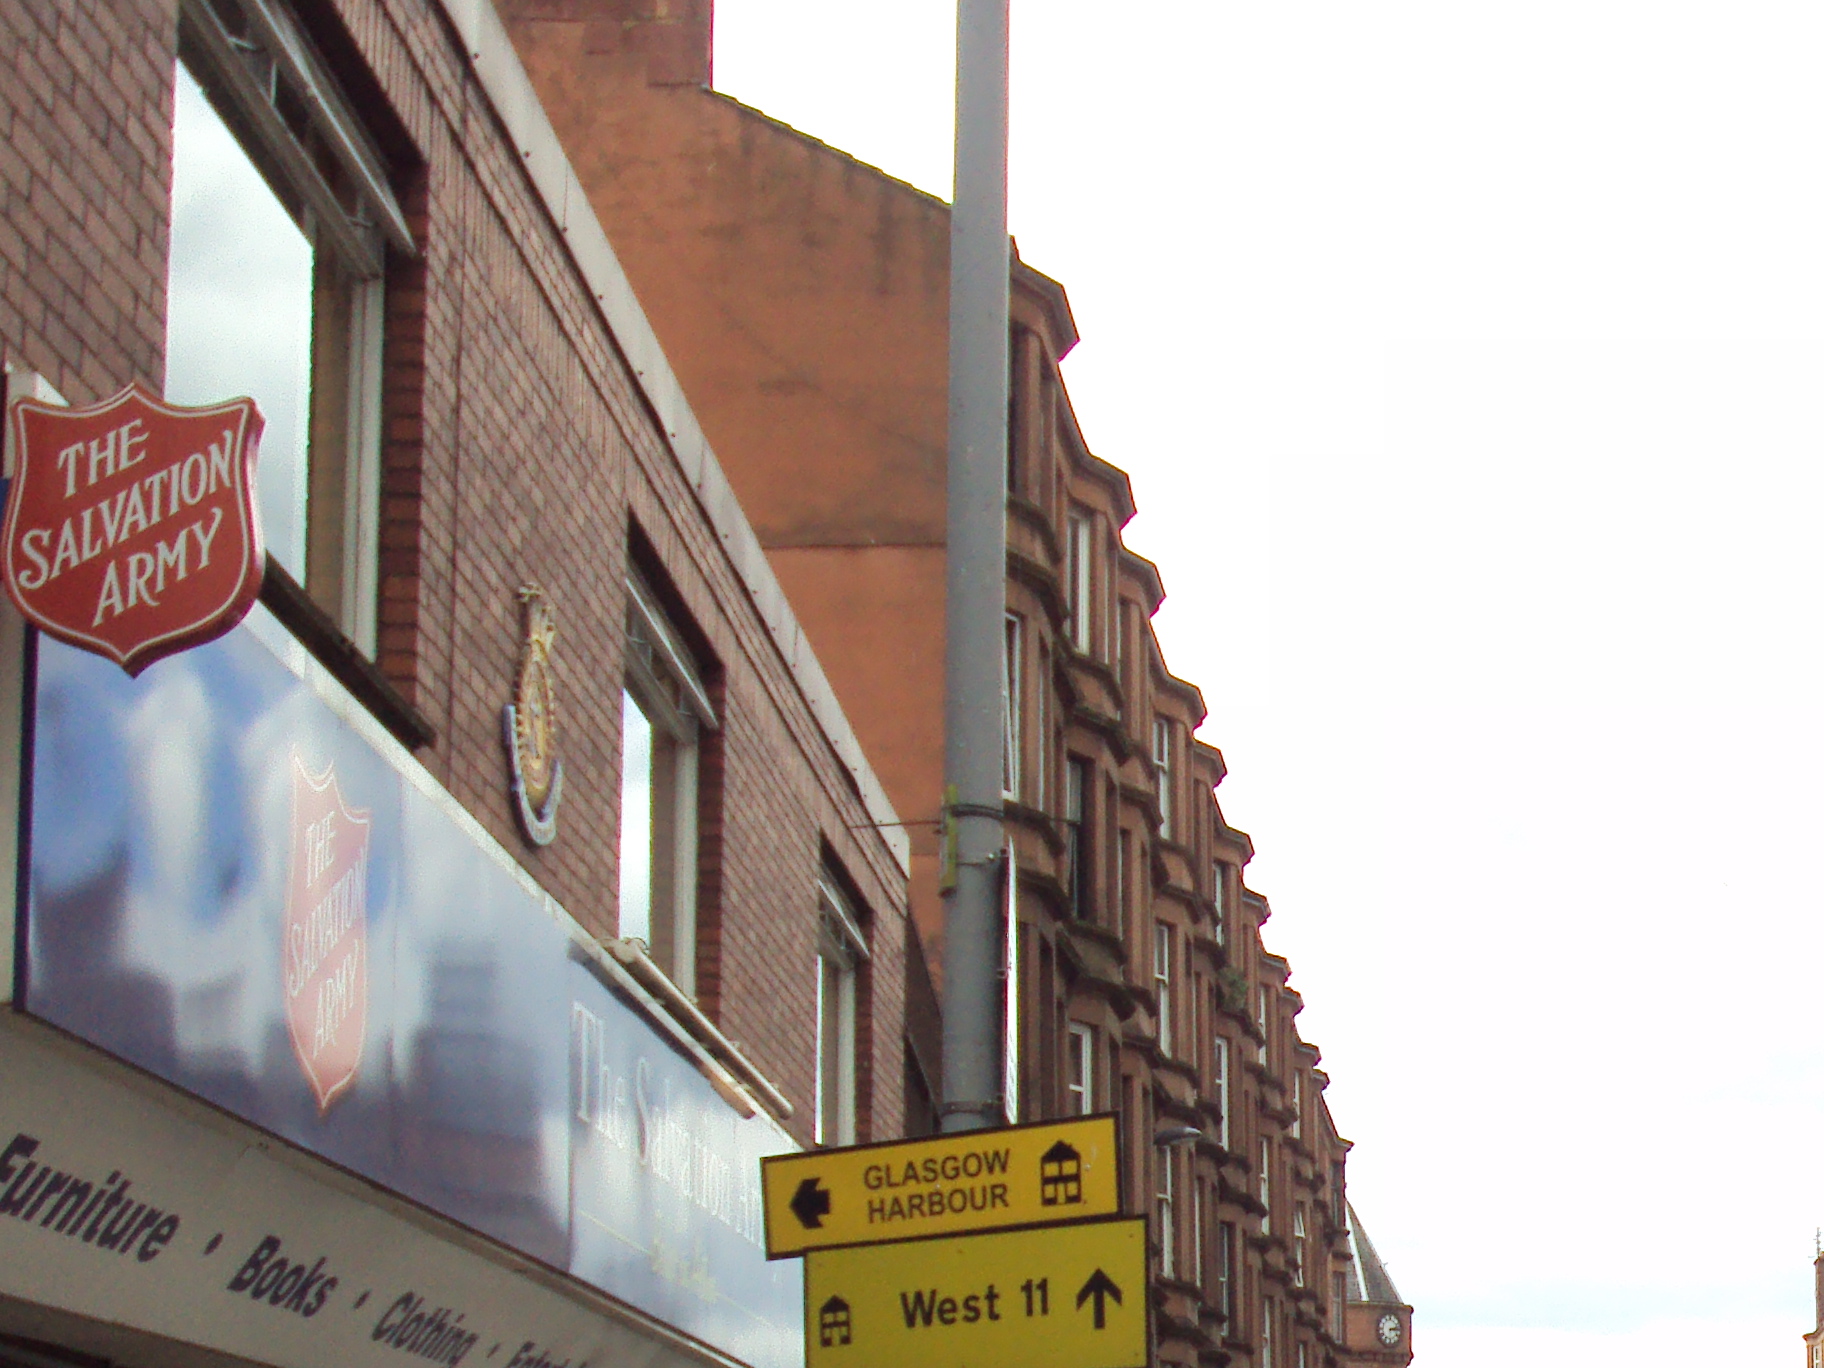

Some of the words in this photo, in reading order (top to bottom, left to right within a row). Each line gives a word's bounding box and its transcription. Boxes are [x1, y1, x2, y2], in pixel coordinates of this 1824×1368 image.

[57, 417, 150, 500] THE
[18, 429, 234, 591] SALVATION
[91, 506, 223, 628] ARMY
[863, 1148, 1011, 1191] GLASGOW
[867, 1183, 1010, 1224] HARBOUR
[0, 1133, 180, 1263] Furniture
[227, 1235, 339, 1318] Books
[899, 1284, 1000, 1328] West
[1020, 1277, 1050, 1318] 11
